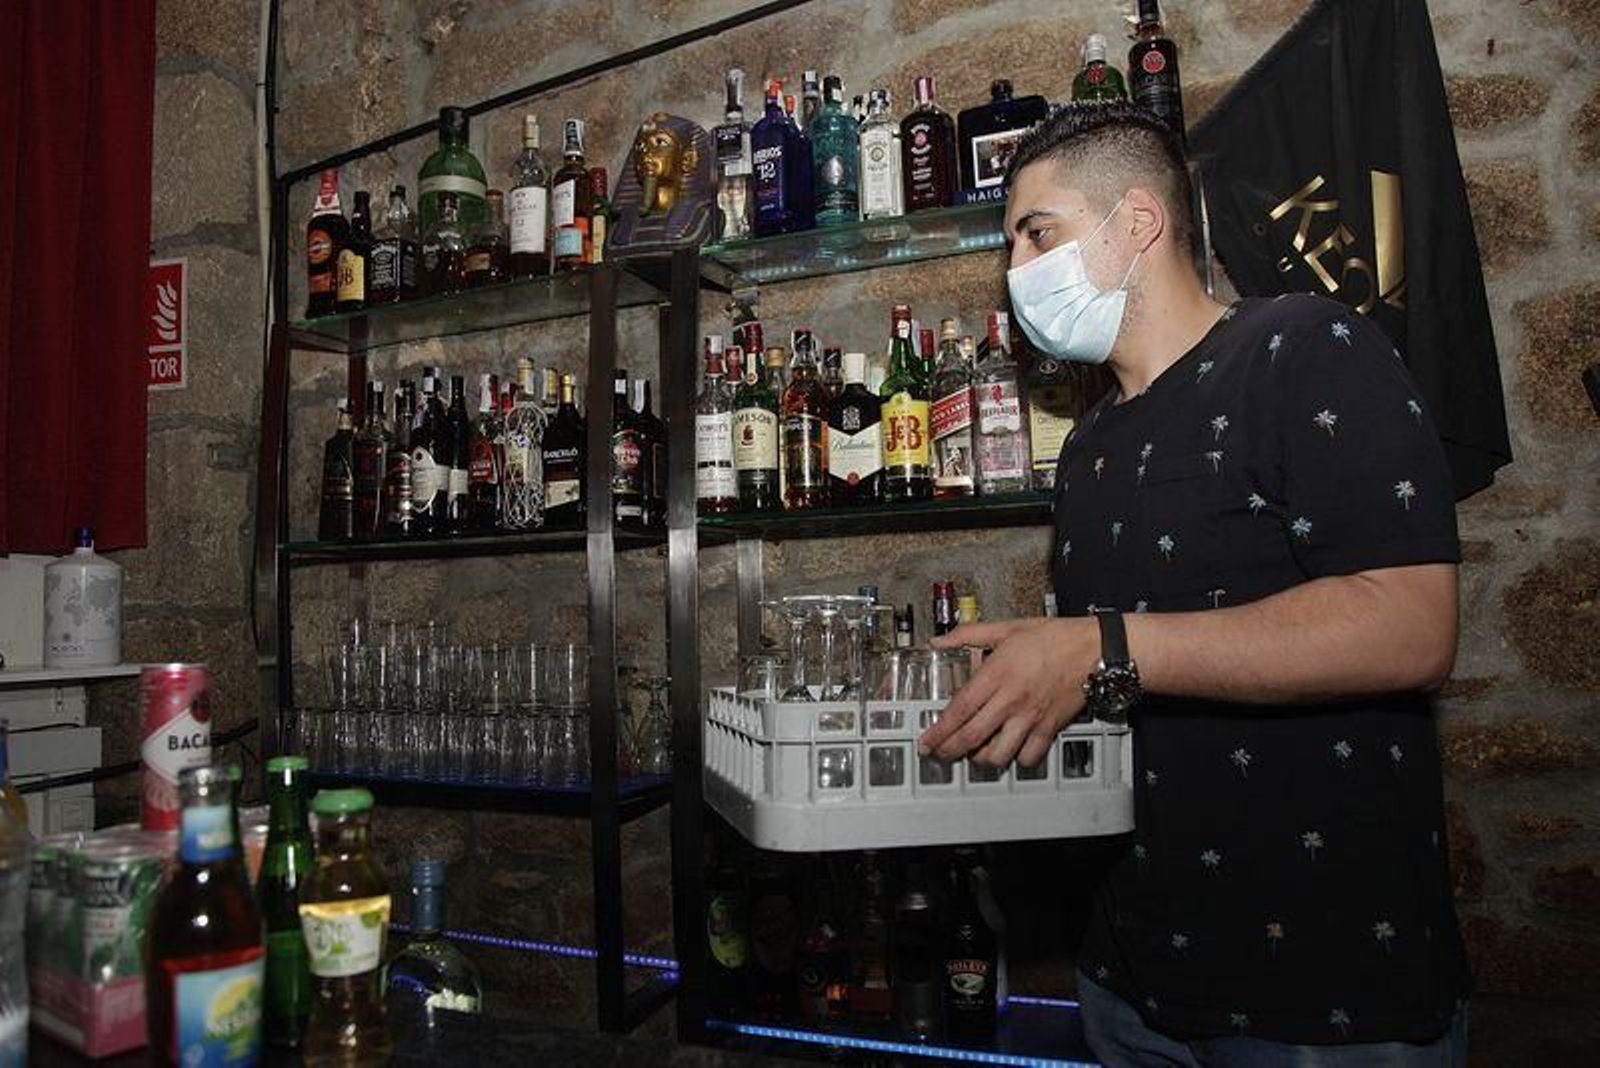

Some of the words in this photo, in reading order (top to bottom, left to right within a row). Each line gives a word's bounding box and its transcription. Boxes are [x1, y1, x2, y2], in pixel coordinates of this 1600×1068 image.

[966, 187, 1003, 203] HAIG
[150, 357, 179, 379] TOR
[886, 414, 923, 453] J&B
